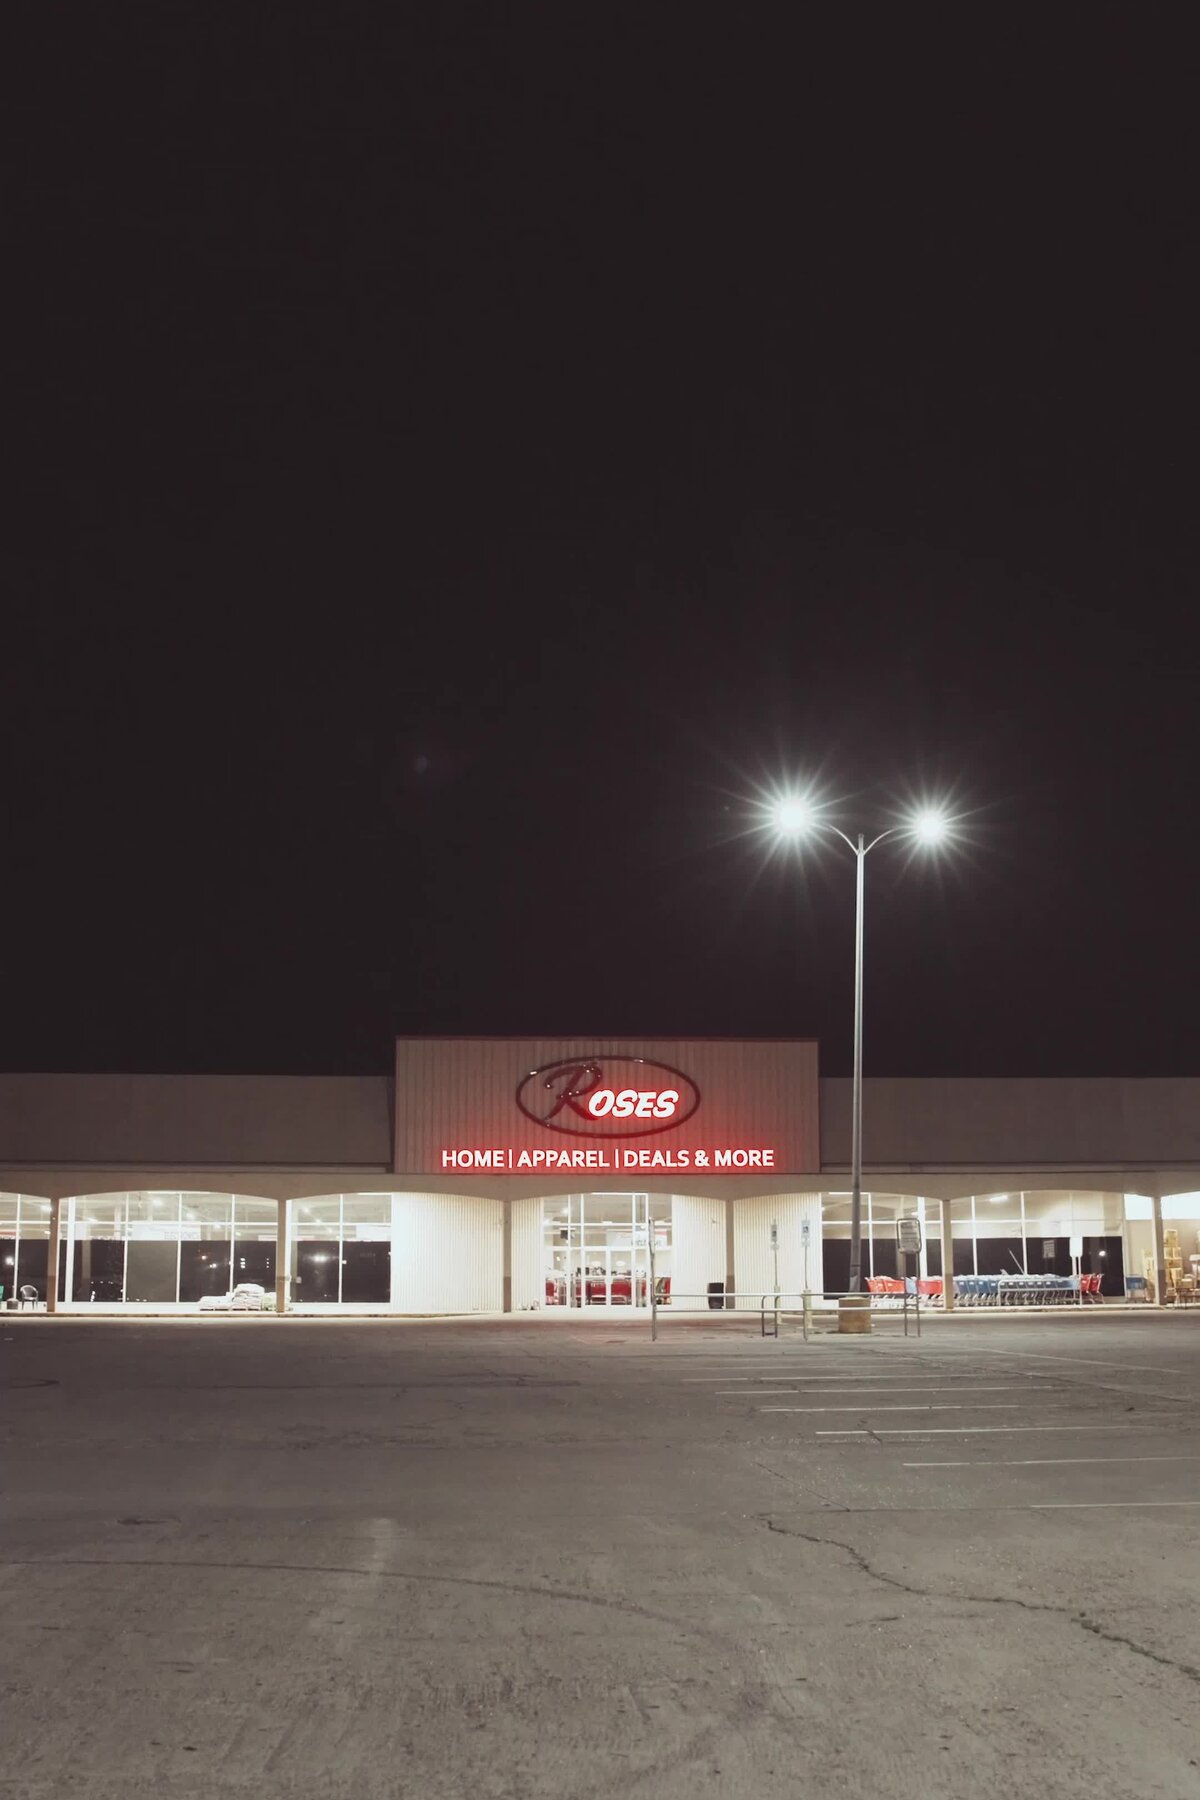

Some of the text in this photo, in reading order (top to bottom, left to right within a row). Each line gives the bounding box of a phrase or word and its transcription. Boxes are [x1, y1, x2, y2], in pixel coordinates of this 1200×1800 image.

[544, 1062, 679, 1120] ROSES
[442, 1149, 505, 1168] HOME
[516, 1149, 611, 1168] APPAREL
[623, 1149, 690, 1168] DEALS
[694, 1150, 711, 1168] &
[714, 1149, 775, 1168] MORE
